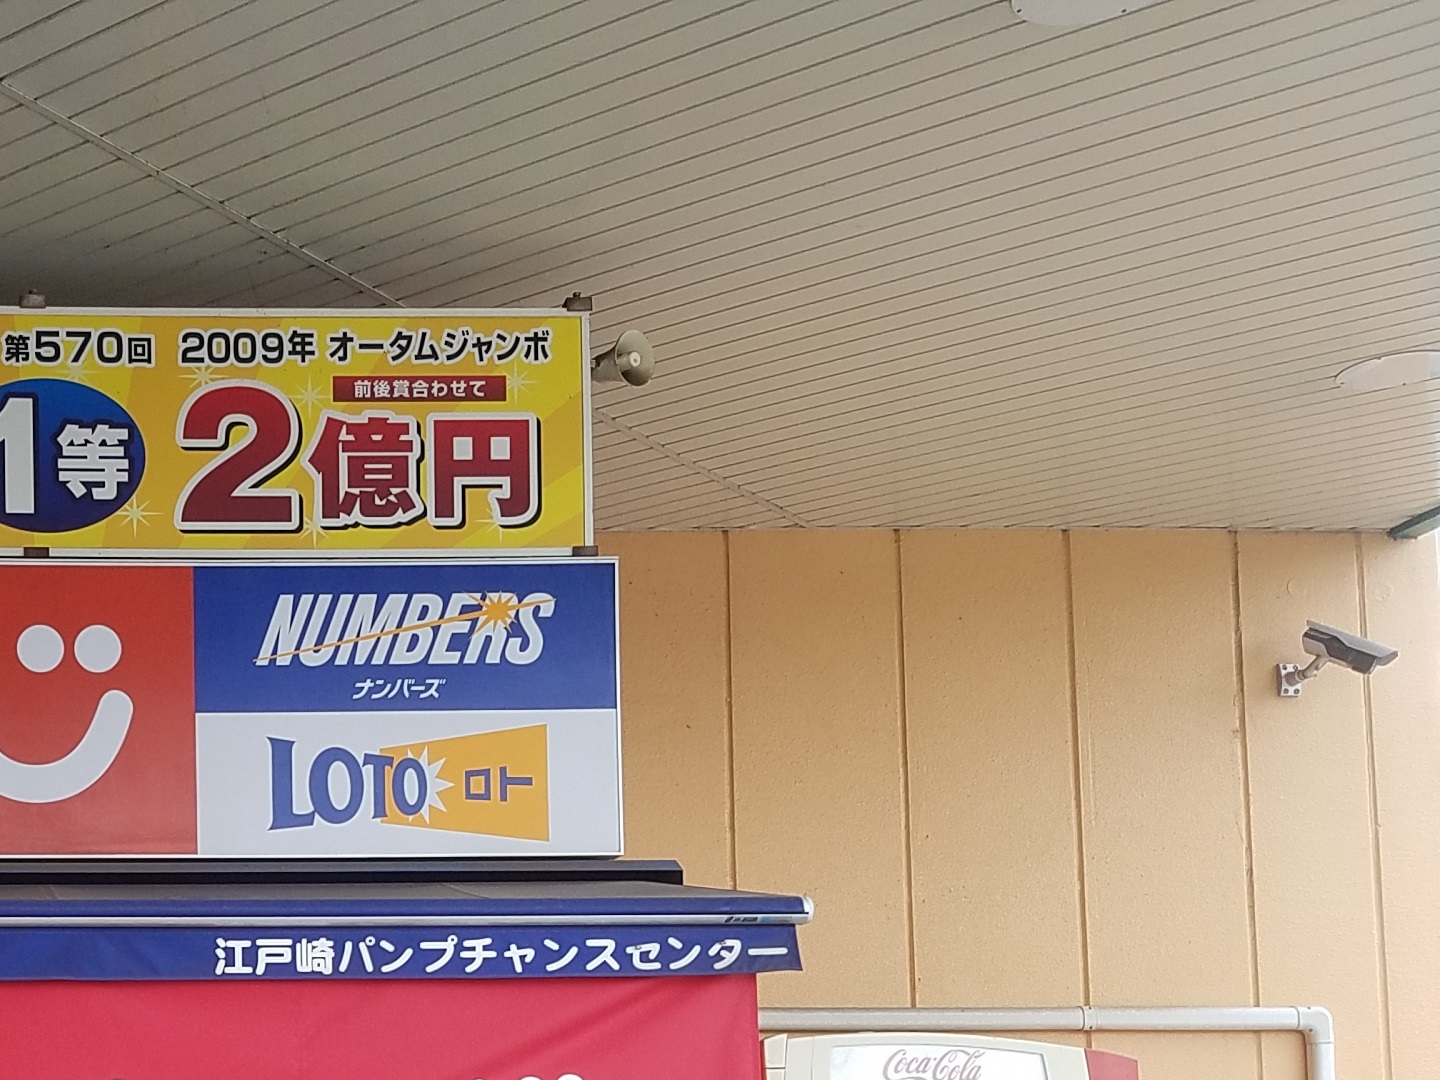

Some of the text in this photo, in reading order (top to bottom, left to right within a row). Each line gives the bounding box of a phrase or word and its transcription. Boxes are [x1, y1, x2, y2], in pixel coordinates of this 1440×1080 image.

[4, 330, 152, 365] 第570回
[180, 330, 317, 364] 2009年
[328, 329, 551, 363] オータムジャンボ
[353, 378, 487, 399] 前後賞合わせて
[178, 383, 536, 528] 2億円
[254, 591, 556, 667] NUMBERS
[352, 678, 447, 700] ナンバーズ
[266, 737, 429, 831] LOTO
[214, 934, 789, 976] 江戸崎パンプチャンスセンター
